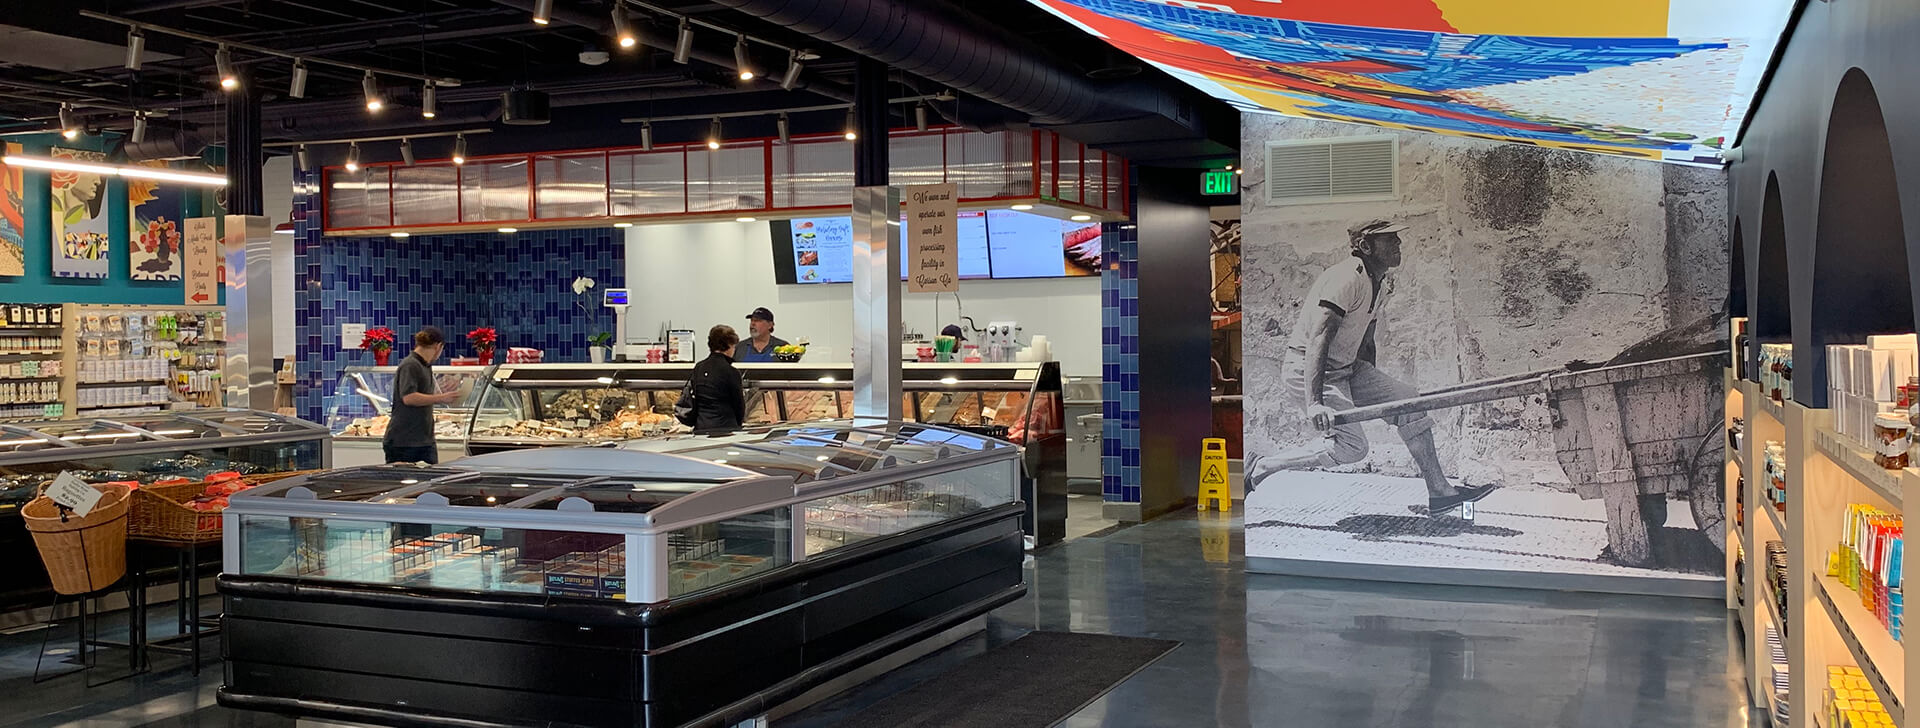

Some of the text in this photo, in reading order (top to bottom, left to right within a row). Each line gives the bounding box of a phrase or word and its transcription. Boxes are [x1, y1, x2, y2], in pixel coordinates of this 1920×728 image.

[1206, 172, 1233, 193] EXIT
[913, 190, 929, 204] We
[940, 191, 950, 200] and
[919, 209, 937, 221] operate
[937, 210, 946, 218] our
[922, 224, 943, 237] own fish
[920, 243, 945, 255] processing
[921, 258, 939, 271] facility
